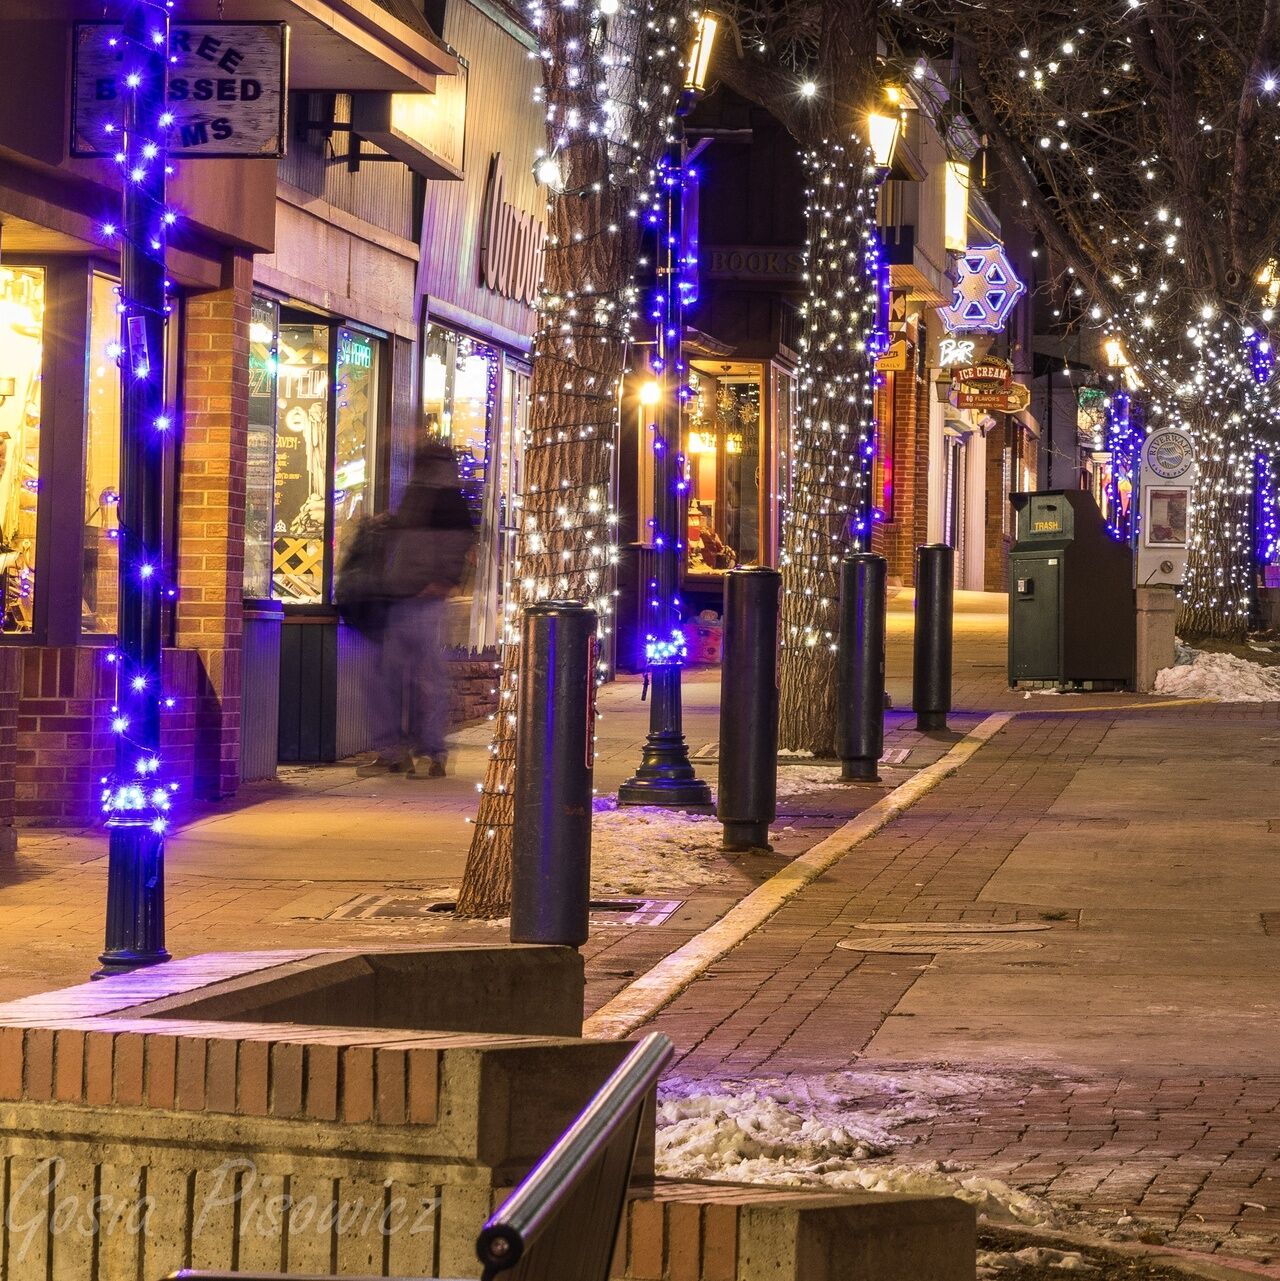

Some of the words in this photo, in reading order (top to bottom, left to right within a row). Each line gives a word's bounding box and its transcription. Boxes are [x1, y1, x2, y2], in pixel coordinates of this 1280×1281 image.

[96, 78, 261, 101] BSSED
[710, 251, 801, 273] BOOKS
[959, 367, 974, 380] ICE
[976, 366, 1007, 379] CREAM
[975, 395, 1000, 403] FLAVORS
[1149, 434, 1192, 457] RIVERWALK
[1034, 521, 1059, 531] TRASH
